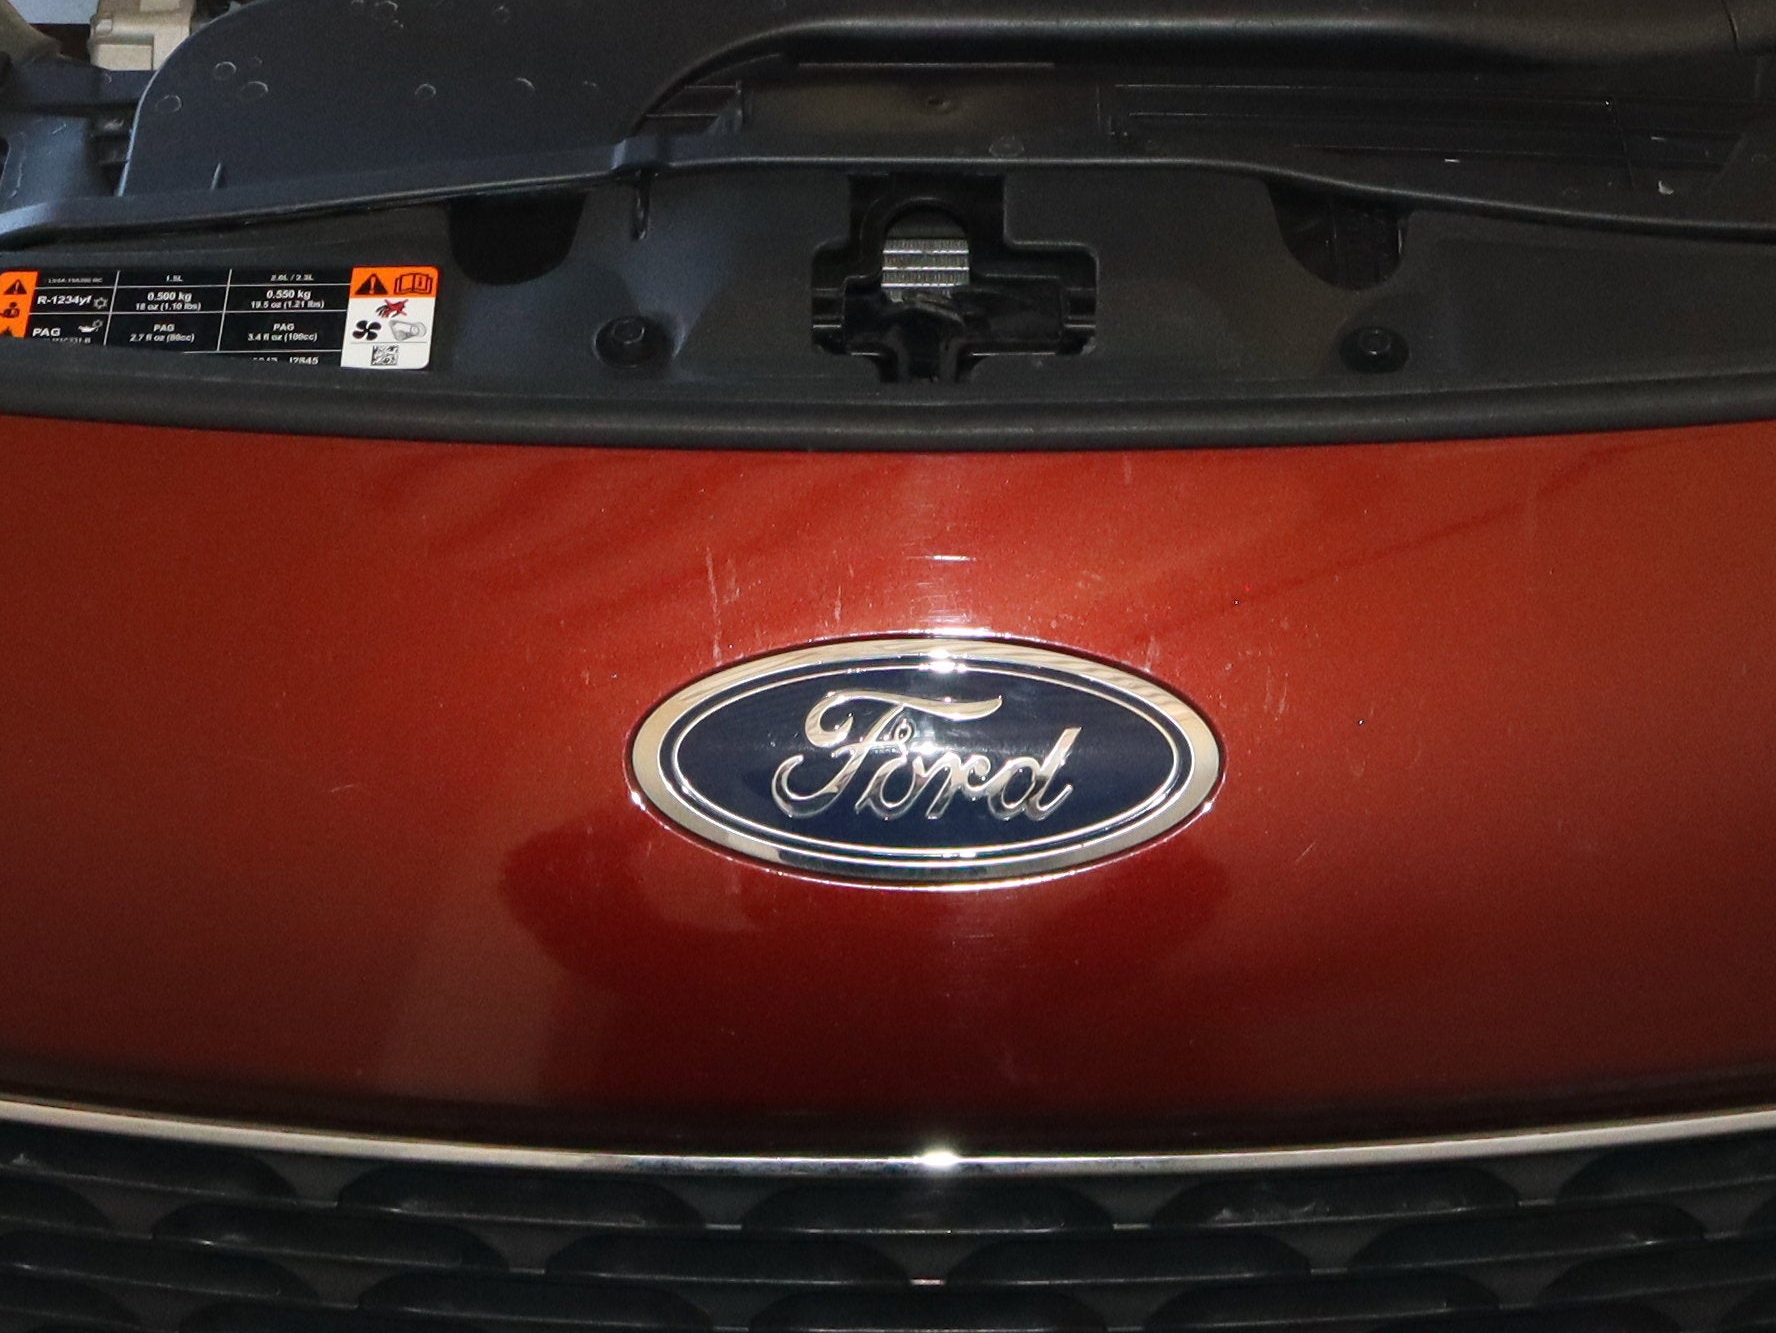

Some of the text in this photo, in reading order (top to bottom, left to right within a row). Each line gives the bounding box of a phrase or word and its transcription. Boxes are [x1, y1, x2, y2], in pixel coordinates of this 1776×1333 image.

[147, 292, 192, 303] 0.500 kg
[266, 289, 312, 301] 0.550 kg
[37, 294, 92, 306] R-1234yf
[147, 303, 159, 311] oz
[153, 324, 175, 332] PAG
[273, 323, 295, 331] PAG
[32, 327, 61, 337] PAG
[247, 332, 262, 341] 3.4
[129, 333, 144, 342] 2.7
[771, 688, 1083, 821] Ford
